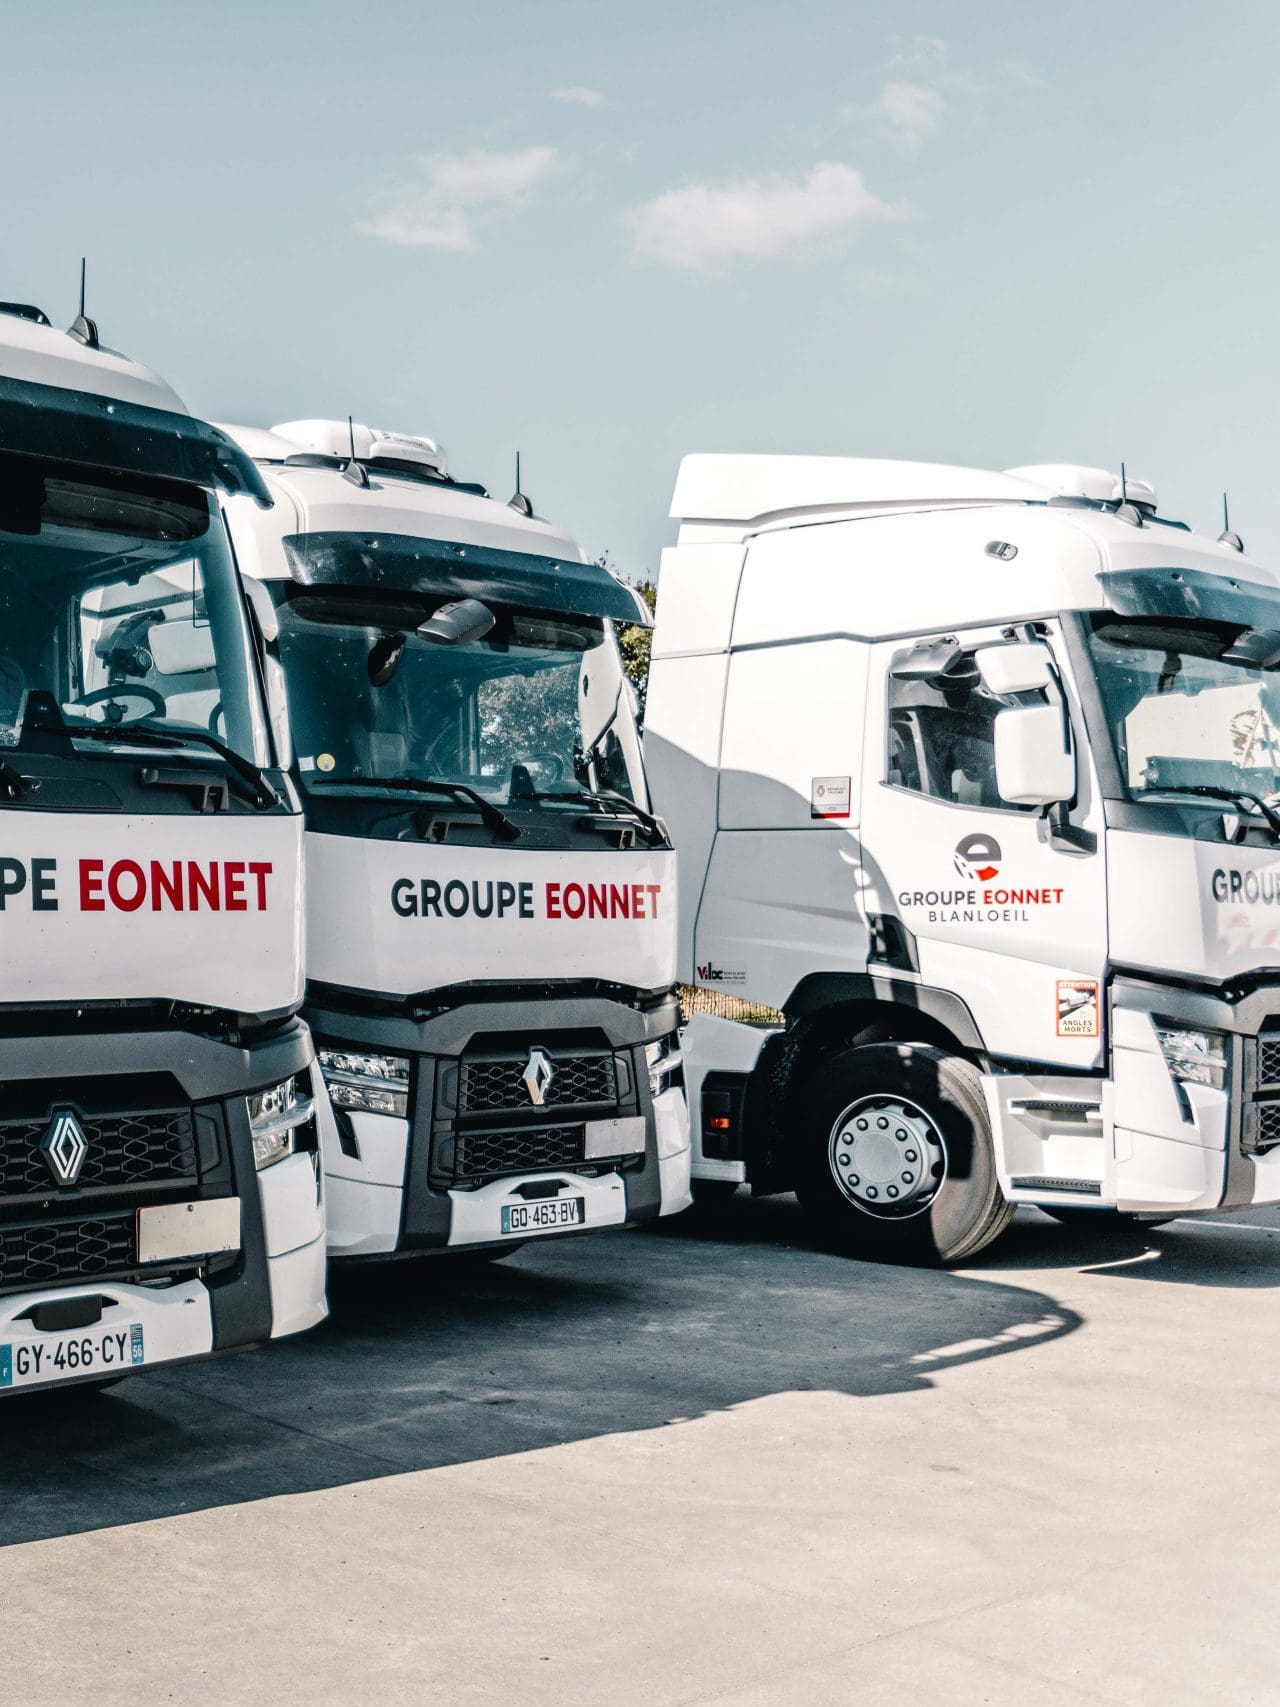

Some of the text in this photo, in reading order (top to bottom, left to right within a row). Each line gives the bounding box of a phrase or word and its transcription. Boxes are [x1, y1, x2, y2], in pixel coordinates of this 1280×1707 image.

[78, 858, 273, 912] EONNET
[391, 878, 661, 919] GROUPE EONNET
[898, 888, 1064, 906] GROUPE EONNET
[928, 910, 1029, 922] BLANLOEIL
[16, 1333, 127, 1375] GY-466-CY
[132, 1345, 142, 1358] 56
